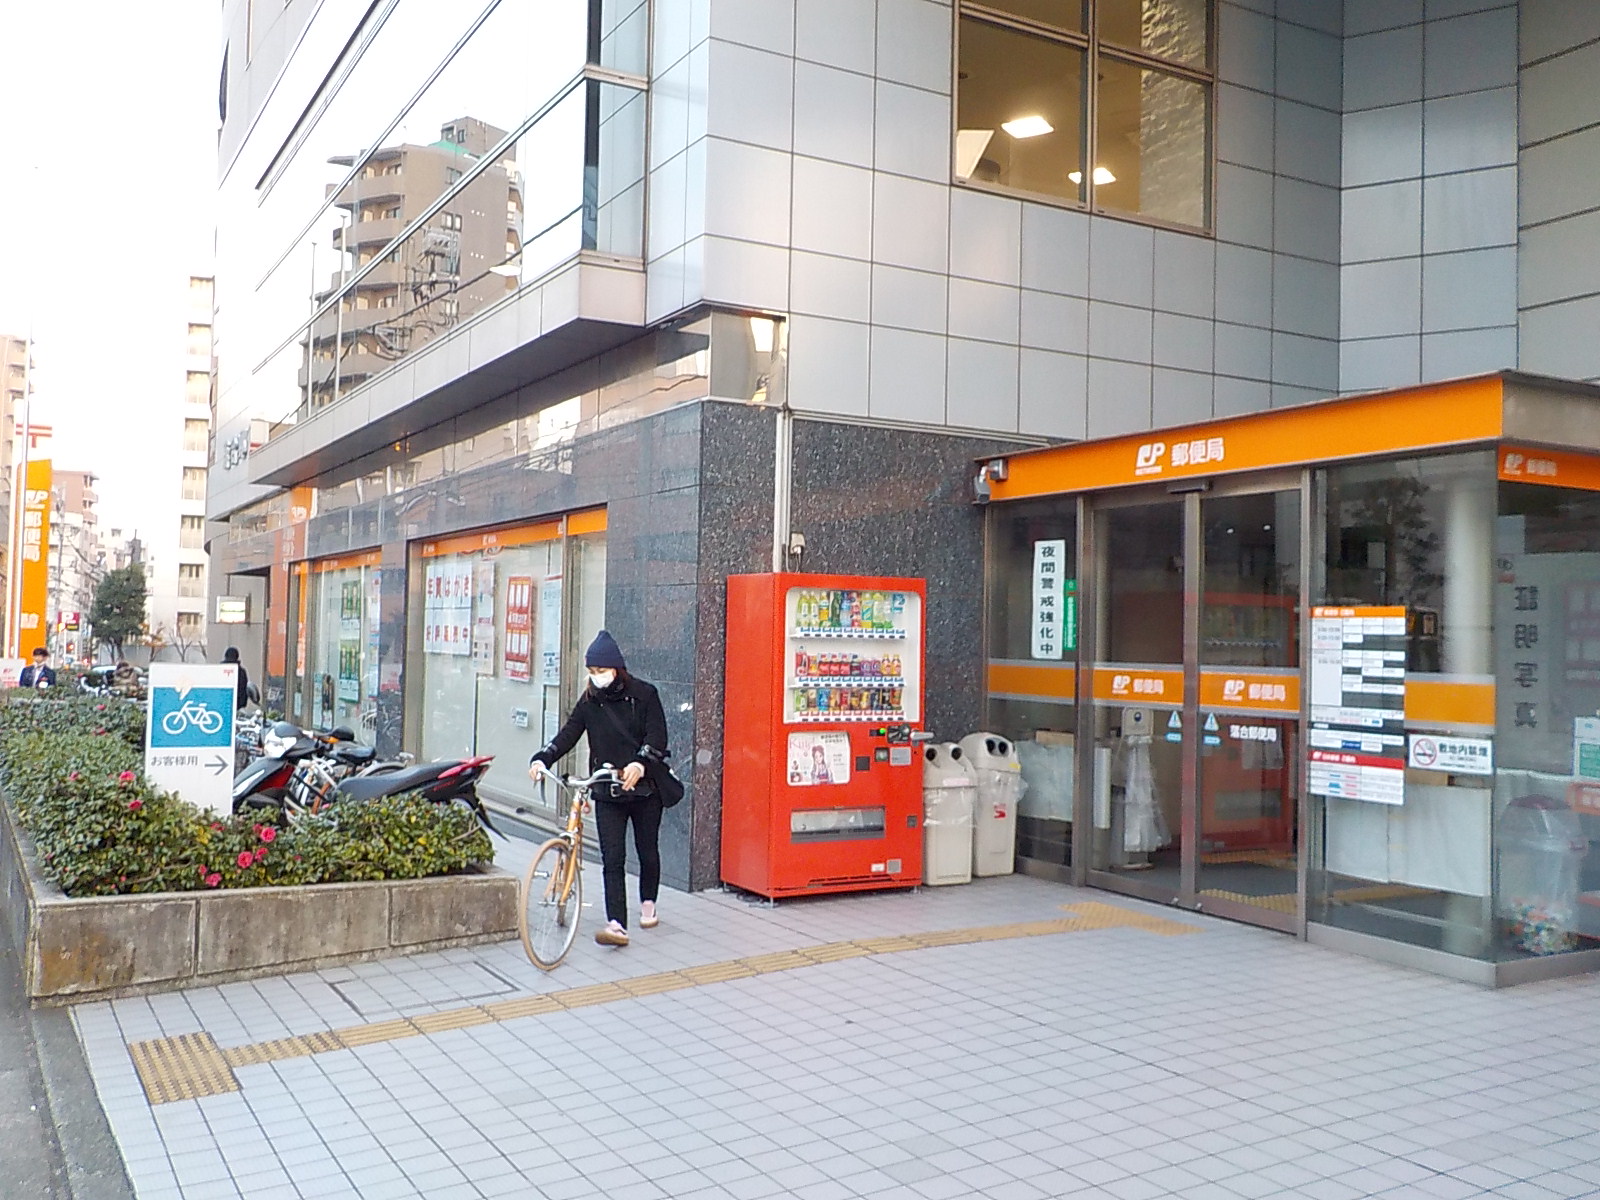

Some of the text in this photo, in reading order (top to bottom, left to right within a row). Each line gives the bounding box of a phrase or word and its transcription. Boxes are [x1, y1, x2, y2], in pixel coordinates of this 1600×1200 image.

[1171, 437, 1224, 467] 郵便局
[427, 576, 469, 599] 年賀はがき
[1039, 545, 1056, 656] 夜間警戒強化中
[1133, 678, 1165, 695] 郵便局
[1249, 683, 1286, 701] 郵便局
[1438, 743, 1488, 757] 敷地内禁煙
[151, 755, 198, 766] お客様用
